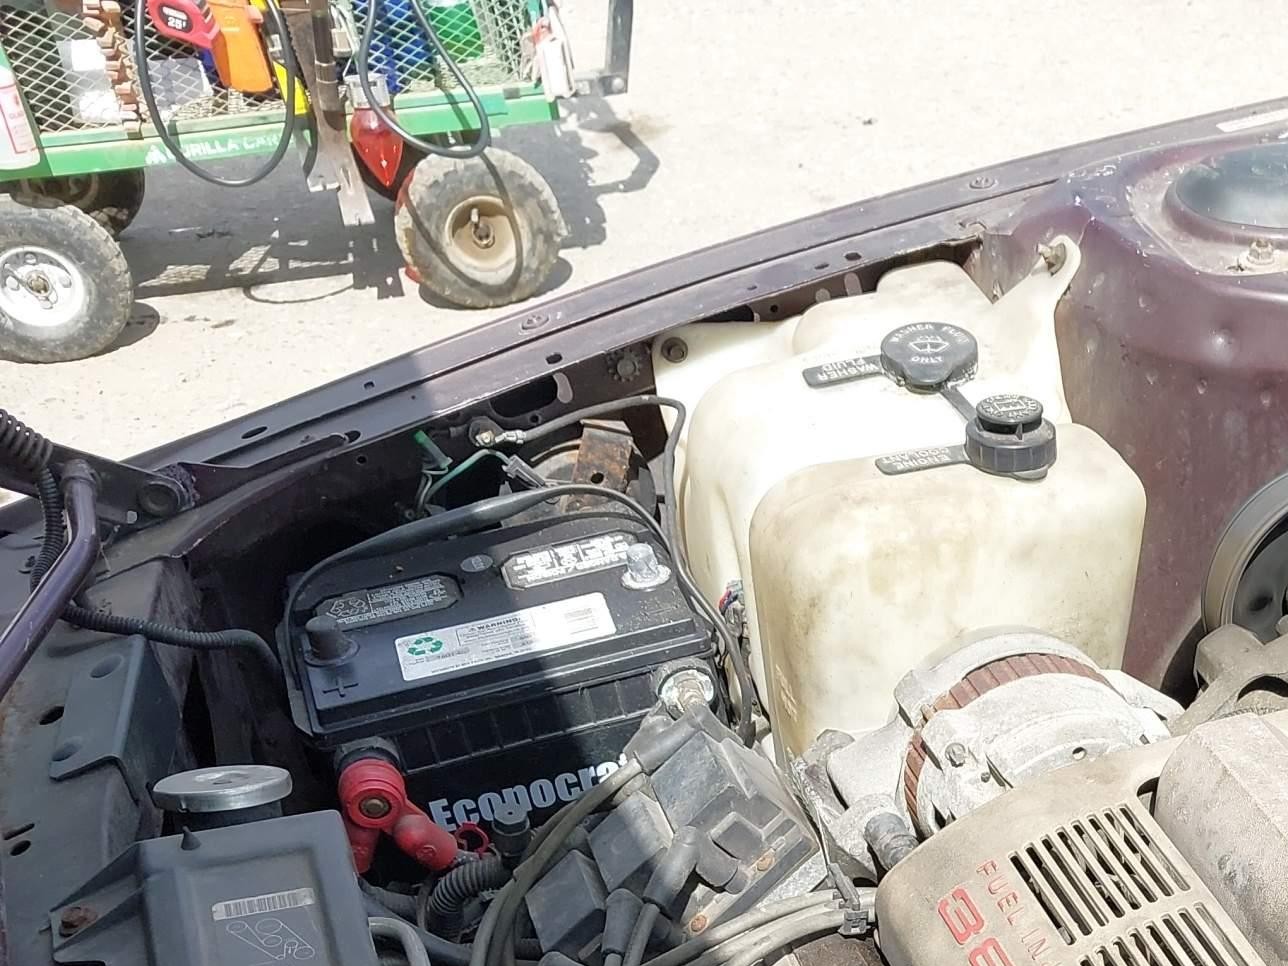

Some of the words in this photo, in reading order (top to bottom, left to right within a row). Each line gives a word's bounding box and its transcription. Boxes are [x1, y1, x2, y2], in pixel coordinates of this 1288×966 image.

[816, 362, 880, 381] WASHER
[821, 357, 868, 371] FLUID
[975, 859, 1025, 927] FUEL
